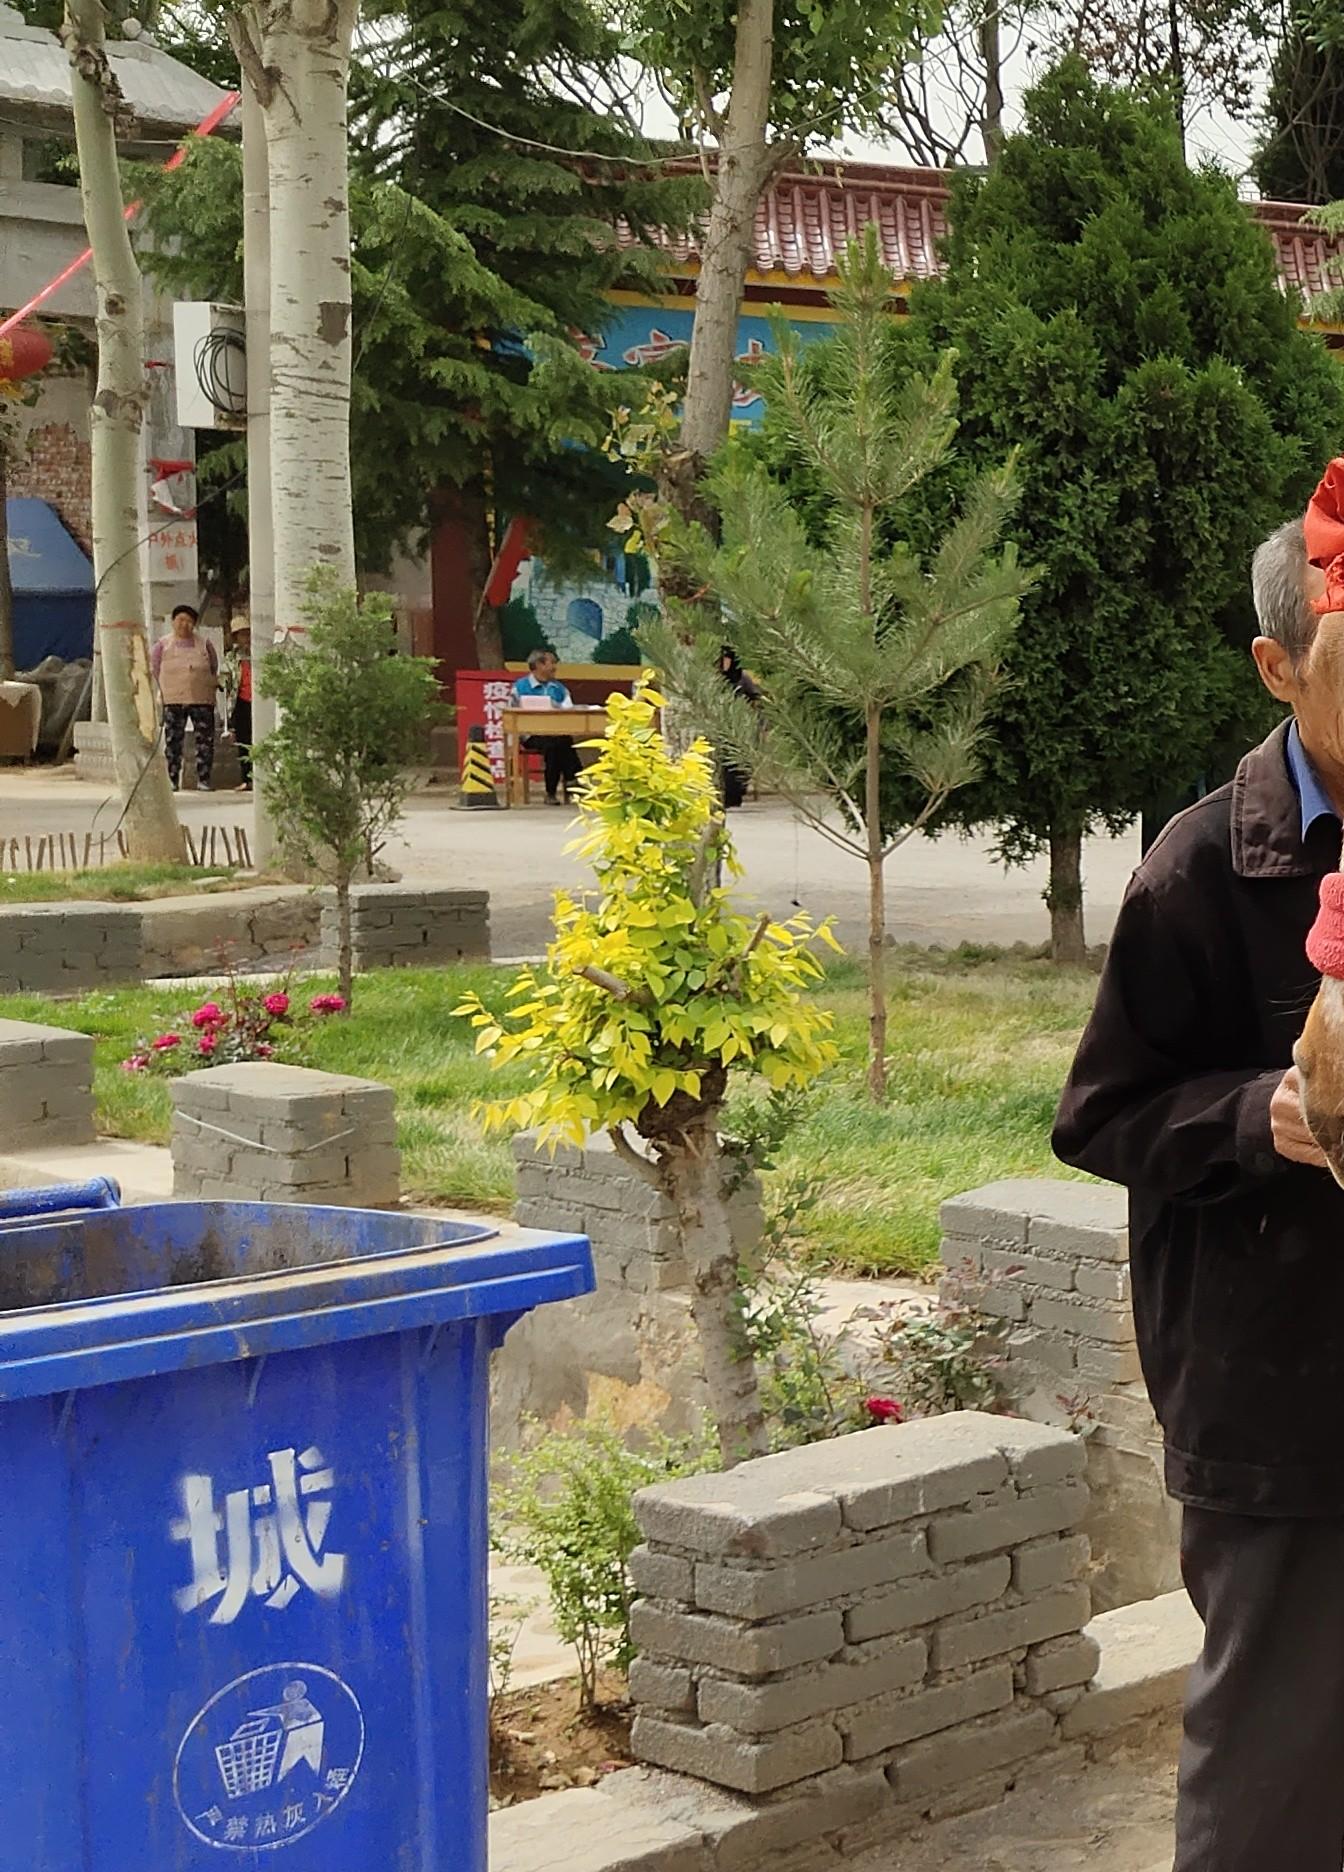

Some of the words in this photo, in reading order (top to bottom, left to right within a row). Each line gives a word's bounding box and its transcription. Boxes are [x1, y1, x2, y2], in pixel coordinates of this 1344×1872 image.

[483, 681, 512, 779] 疫情检查点
[170, 1447, 346, 1625] 城
[195, 1767, 350, 1841] 严禁热灰入桶
